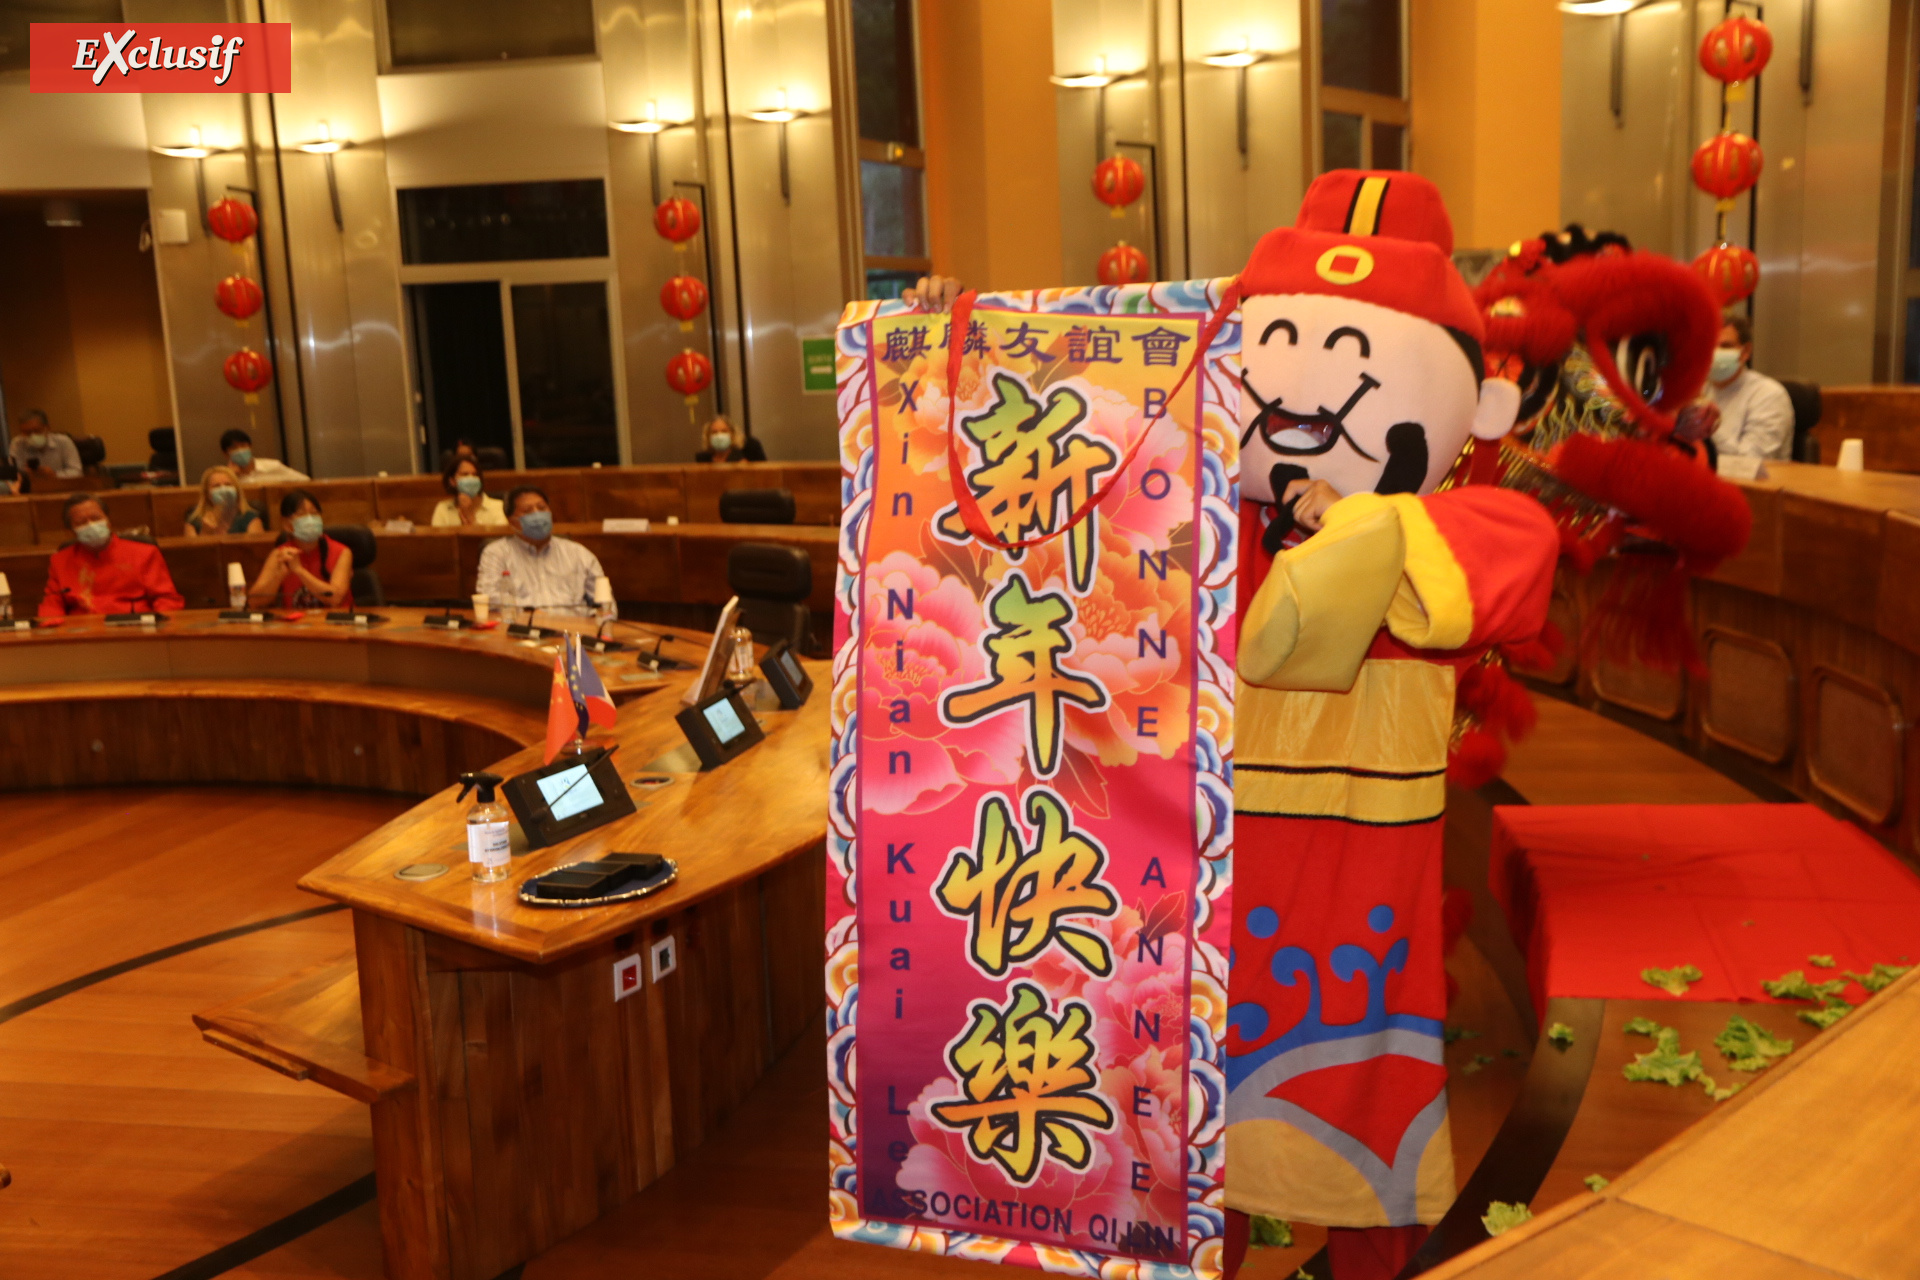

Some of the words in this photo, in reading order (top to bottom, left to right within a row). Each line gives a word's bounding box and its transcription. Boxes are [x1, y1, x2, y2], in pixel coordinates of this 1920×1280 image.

[892, 380, 919, 516] Xin
[1137, 387, 1171, 738] BONNE
[887, 588, 914, 775] Nian
[930, 372, 1118, 1184] 新年快樂
[887, 842, 916, 1019] Kuai
[1131, 857, 1167, 1192] ANNEE
[872, 1187, 1072, 1235] ASSOCIATION
[888, 1085, 911, 1162] Le
